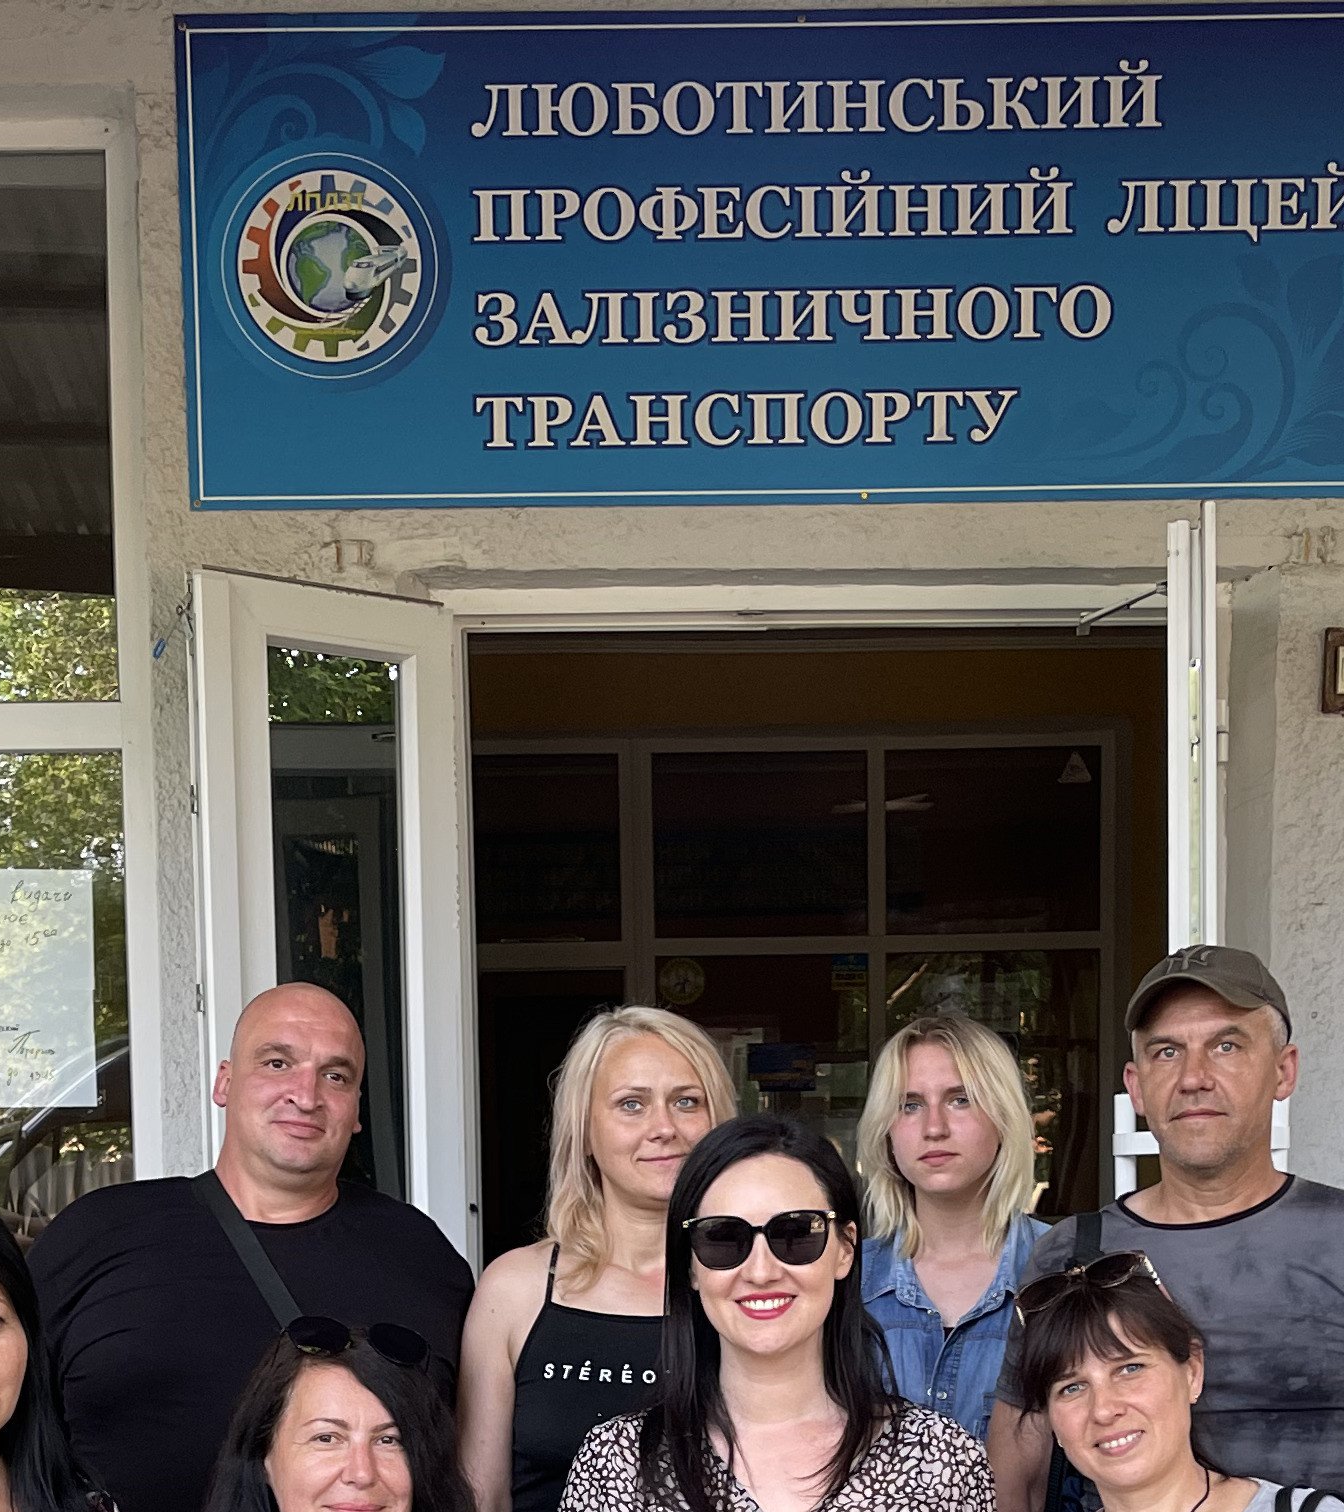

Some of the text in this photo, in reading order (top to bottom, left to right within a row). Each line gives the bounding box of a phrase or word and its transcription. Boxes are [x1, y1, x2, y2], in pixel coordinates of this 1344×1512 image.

[471, 60, 1163, 137] ЛЮБОТИНСЬКИЙ
[472, 166, 1074, 241] ПРОФЕСІЙНИЙ
[474, 285, 1113, 347] ЗАЛІЗНИЧНОГО
[476, 390, 1019, 449] ТРАНСПОРТУ
[543, 1360, 657, 1384] STÉRÉO
